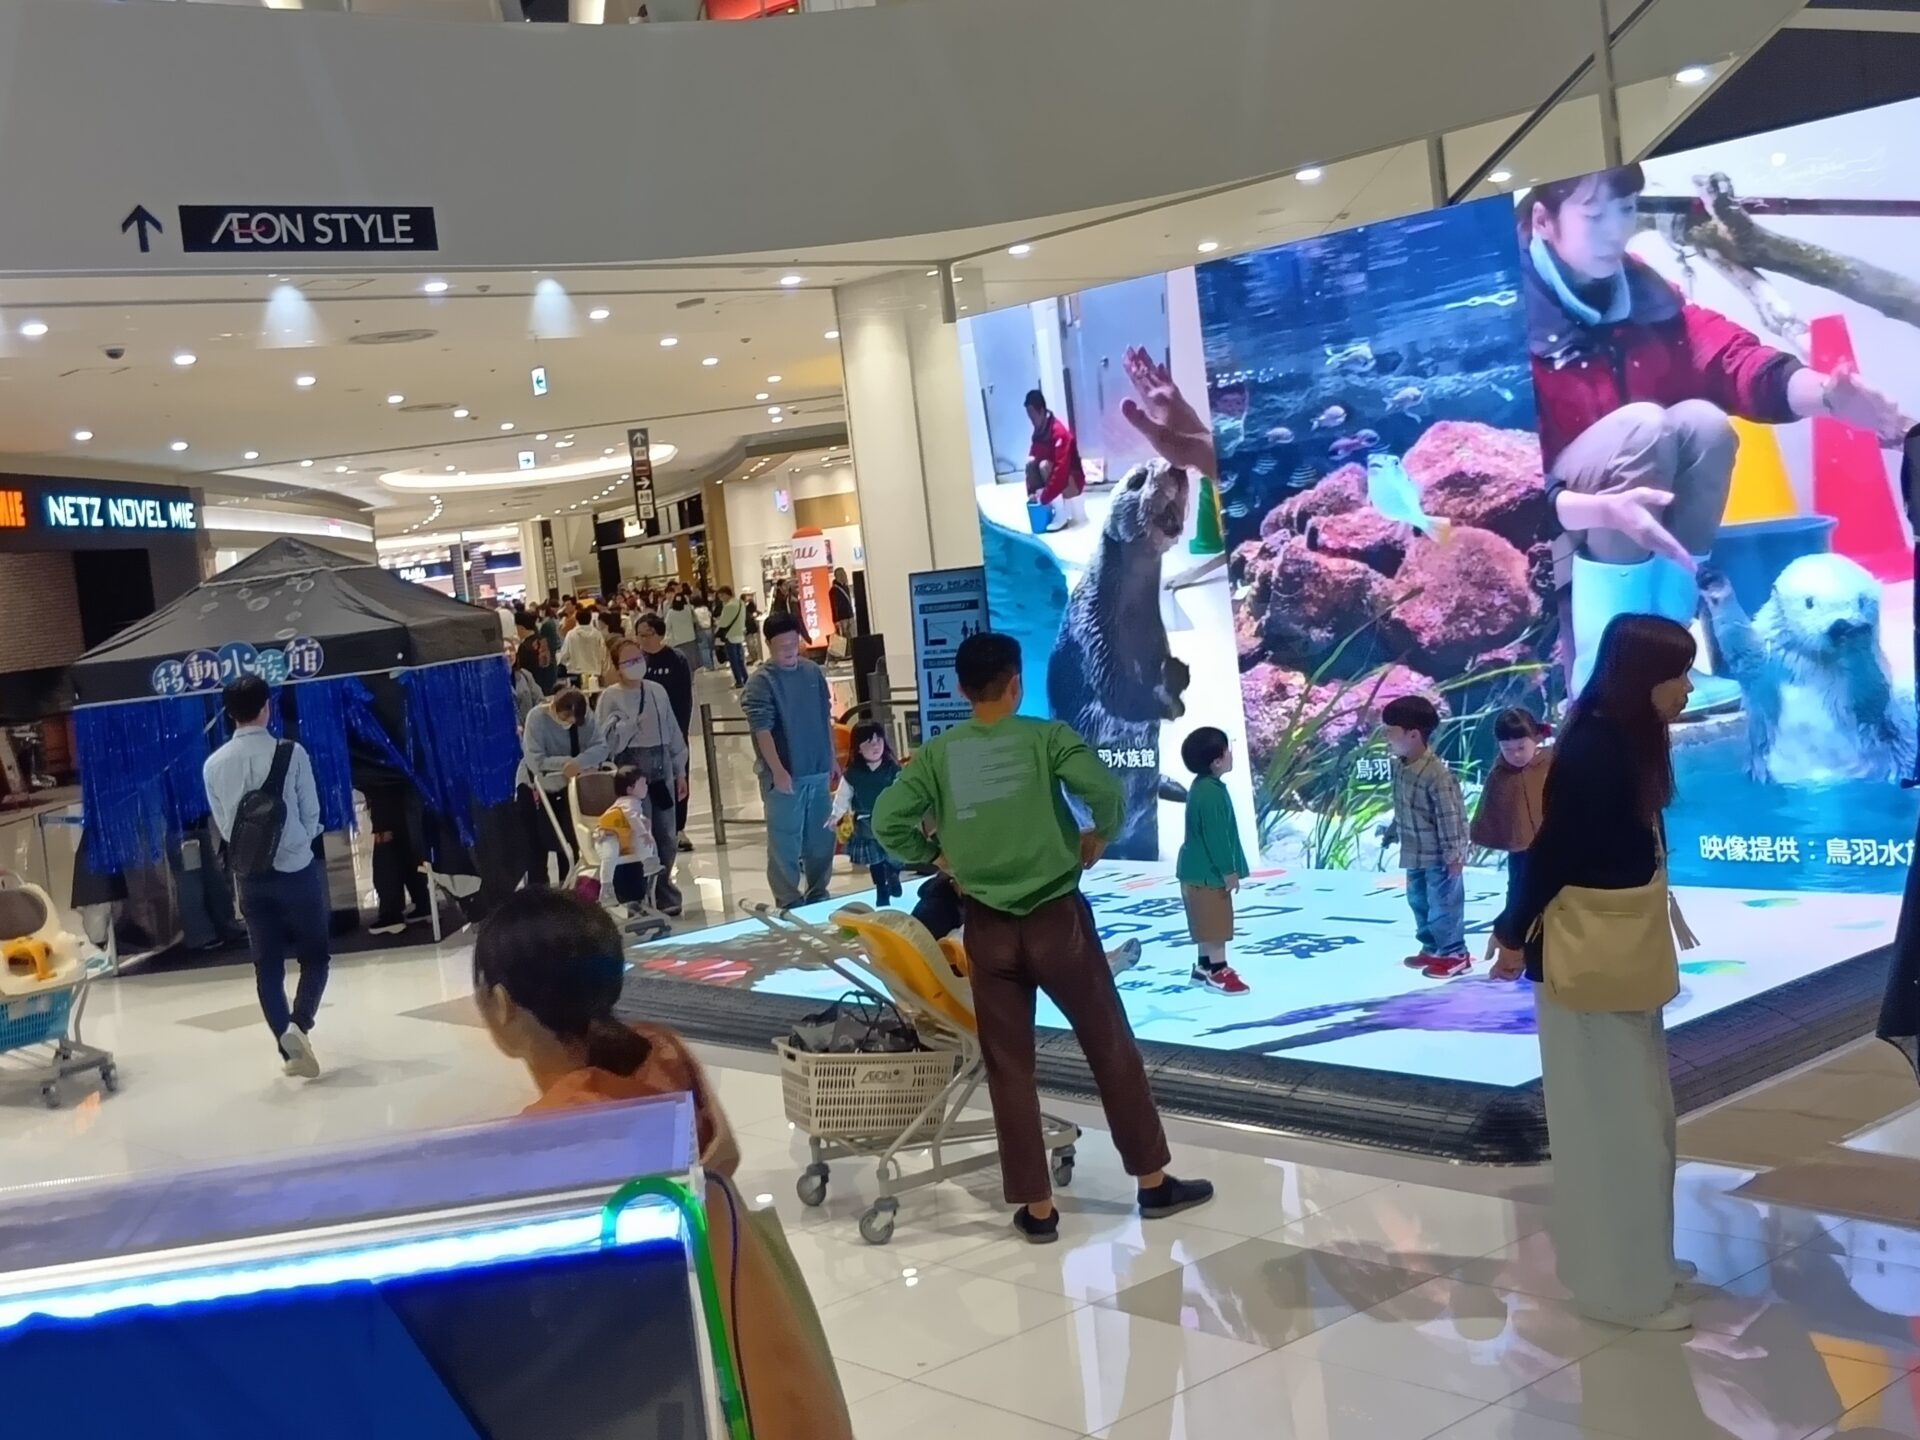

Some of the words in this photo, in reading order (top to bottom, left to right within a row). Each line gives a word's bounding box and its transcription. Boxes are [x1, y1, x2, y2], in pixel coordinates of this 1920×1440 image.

[313, 213, 414, 244] STYLE
[48, 496, 104, 527] NETZ
[109, 498, 167, 528] NOVEL
[169, 502, 196, 529] MIE
[155, 640, 320, 693] 移動水族館
